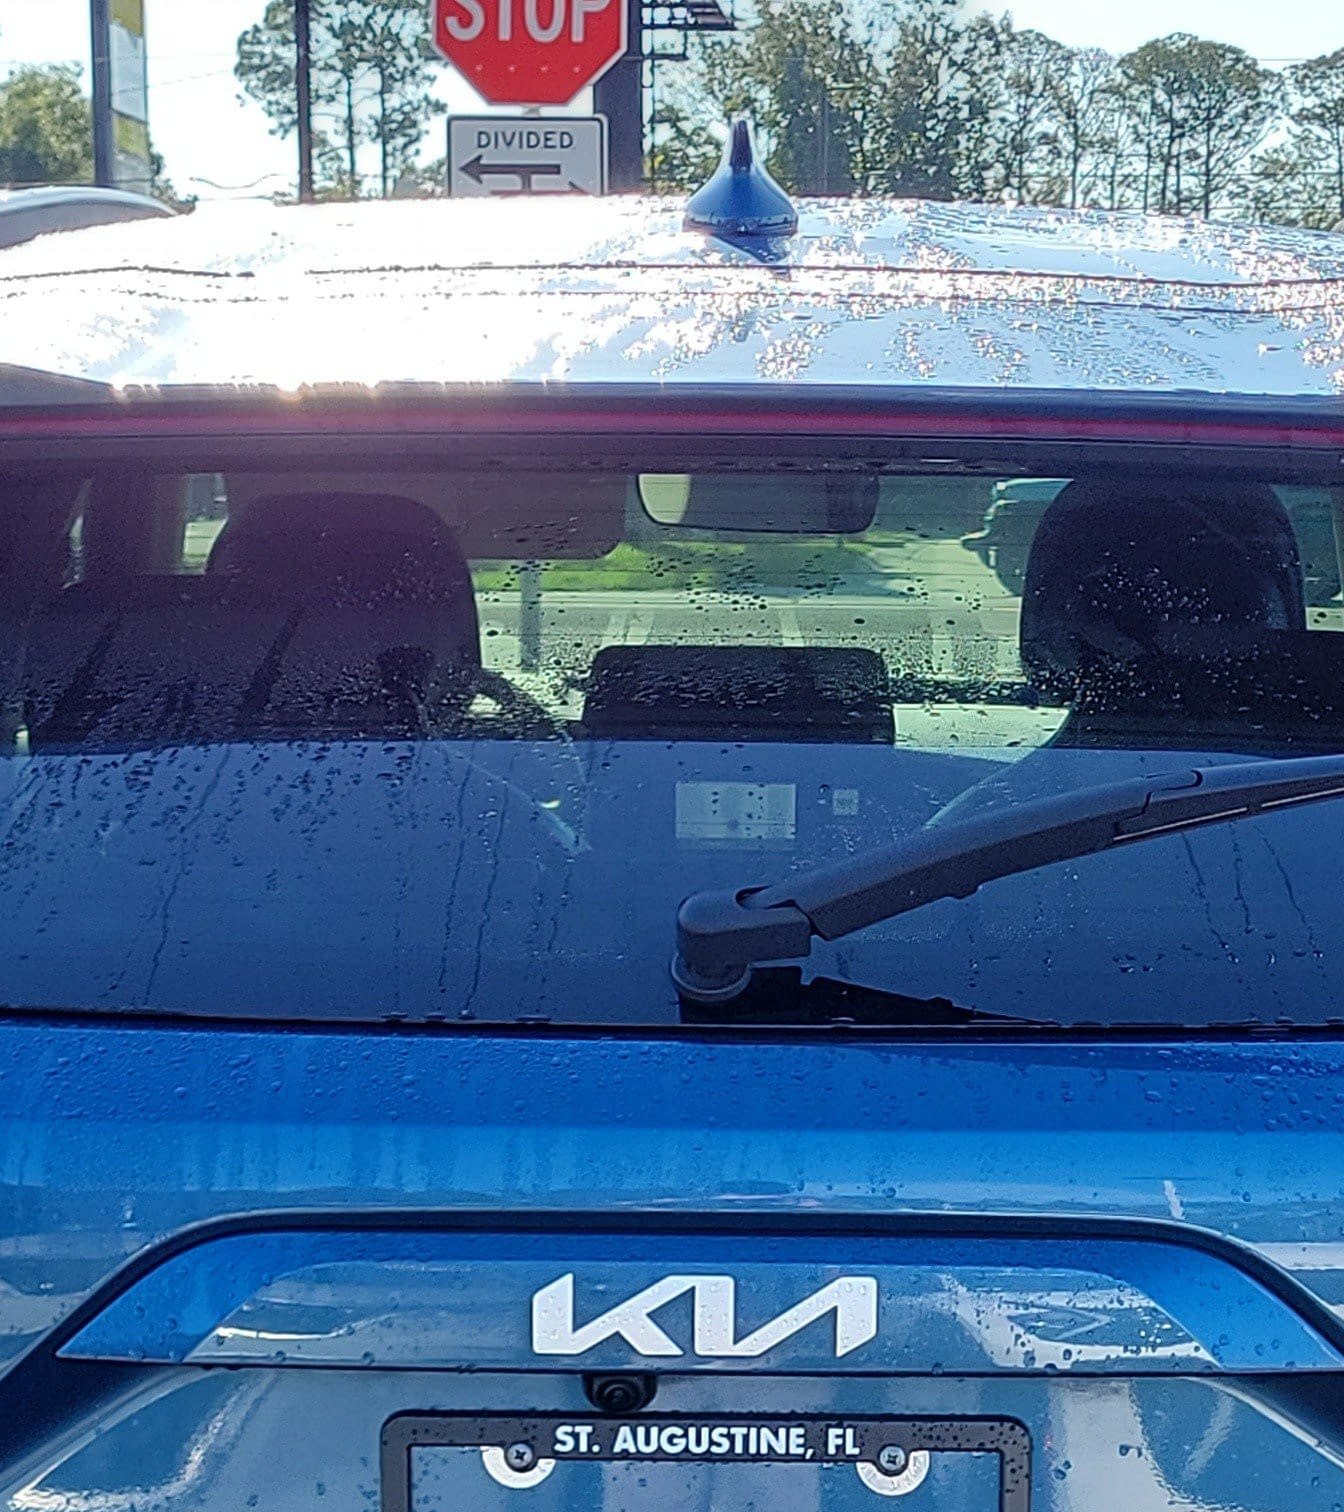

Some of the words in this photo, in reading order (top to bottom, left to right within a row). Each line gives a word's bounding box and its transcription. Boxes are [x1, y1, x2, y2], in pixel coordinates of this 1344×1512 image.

[445, 0, 608, 43] STOP
[476, 130, 574, 149] DIVIDED
[531, 1273, 878, 1358] KIA
[553, 1424, 600, 1455] ST.
[612, 1425, 815, 1458] AUGUSTINE,
[826, 1426, 860, 1456] FL
